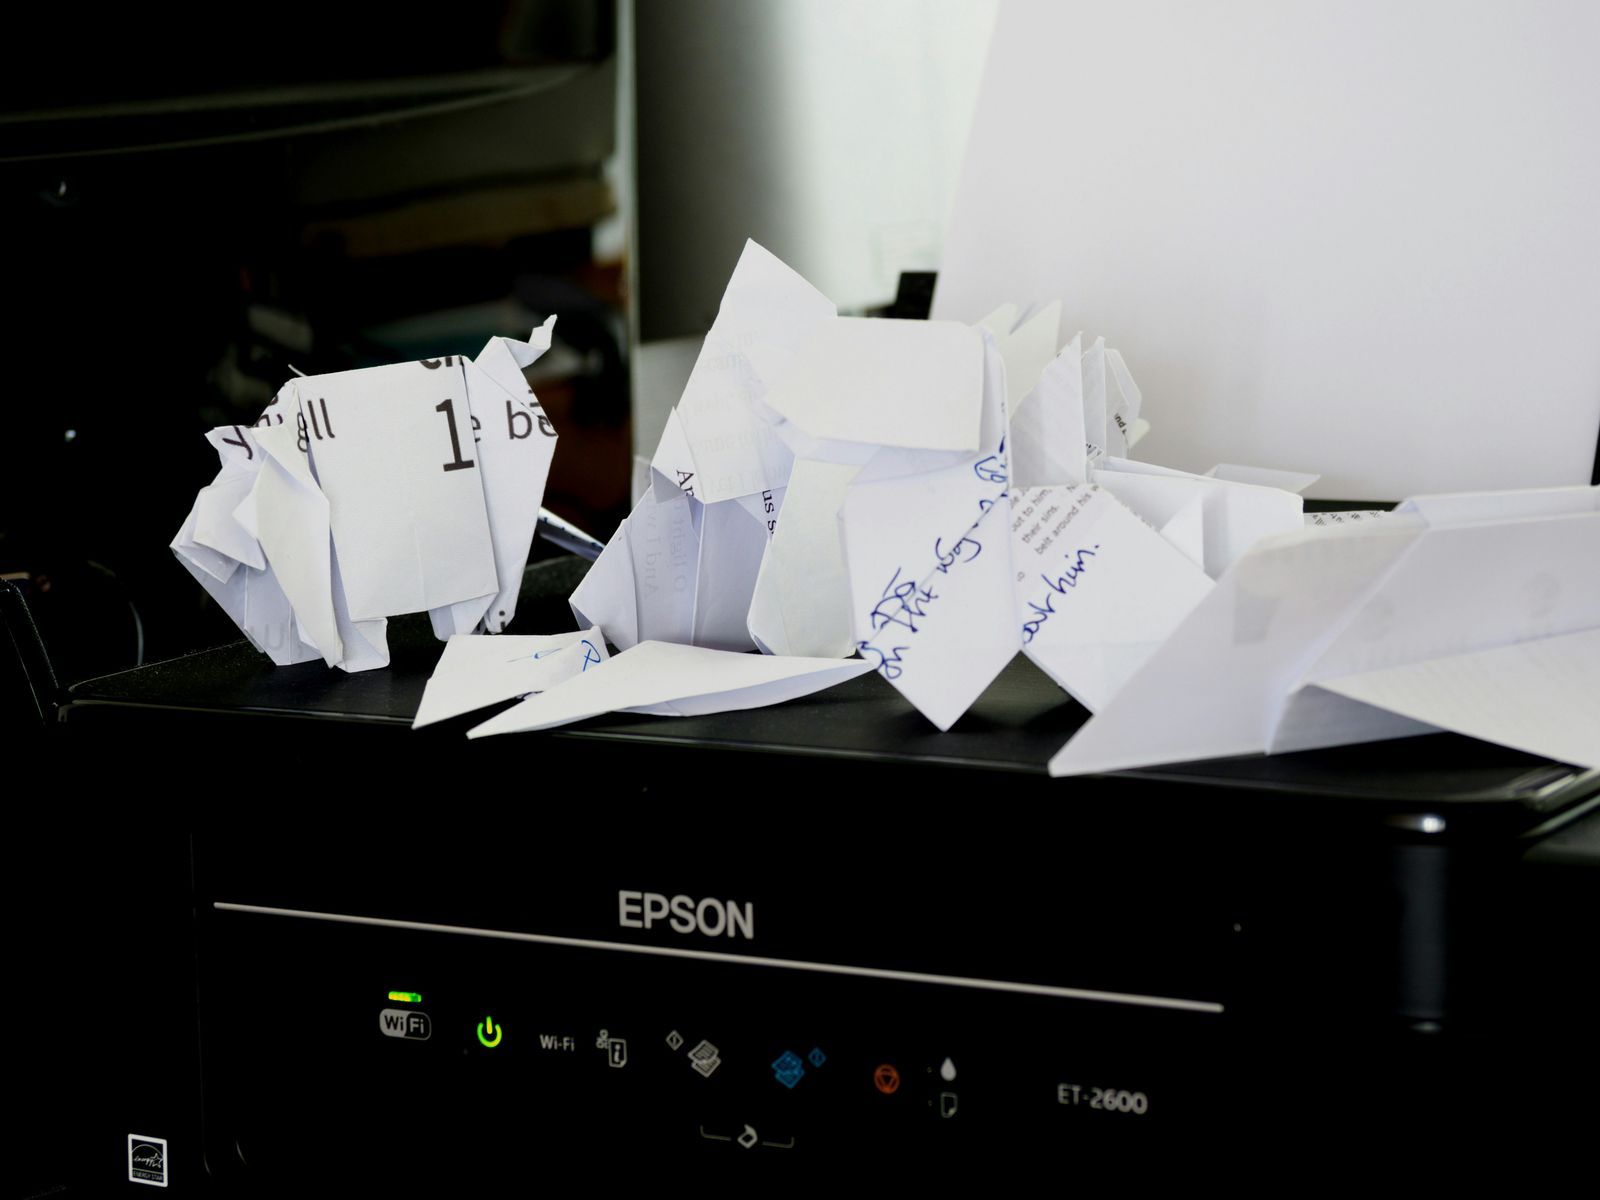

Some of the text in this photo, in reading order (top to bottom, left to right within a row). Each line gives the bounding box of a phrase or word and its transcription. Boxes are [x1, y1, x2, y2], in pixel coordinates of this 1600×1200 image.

[435, 398, 475, 472] 1
[1022, 505, 1058, 543] their sins.
[1035, 537, 1053, 555] belt
[1053, 505, 1079, 537] around
[1078, 493, 1091, 507] his
[618, 890, 754, 940] EPSON
[539, 1033, 576, 1052] Wi-Fi
[1056, 1082, 1149, 1115] ET-2600
